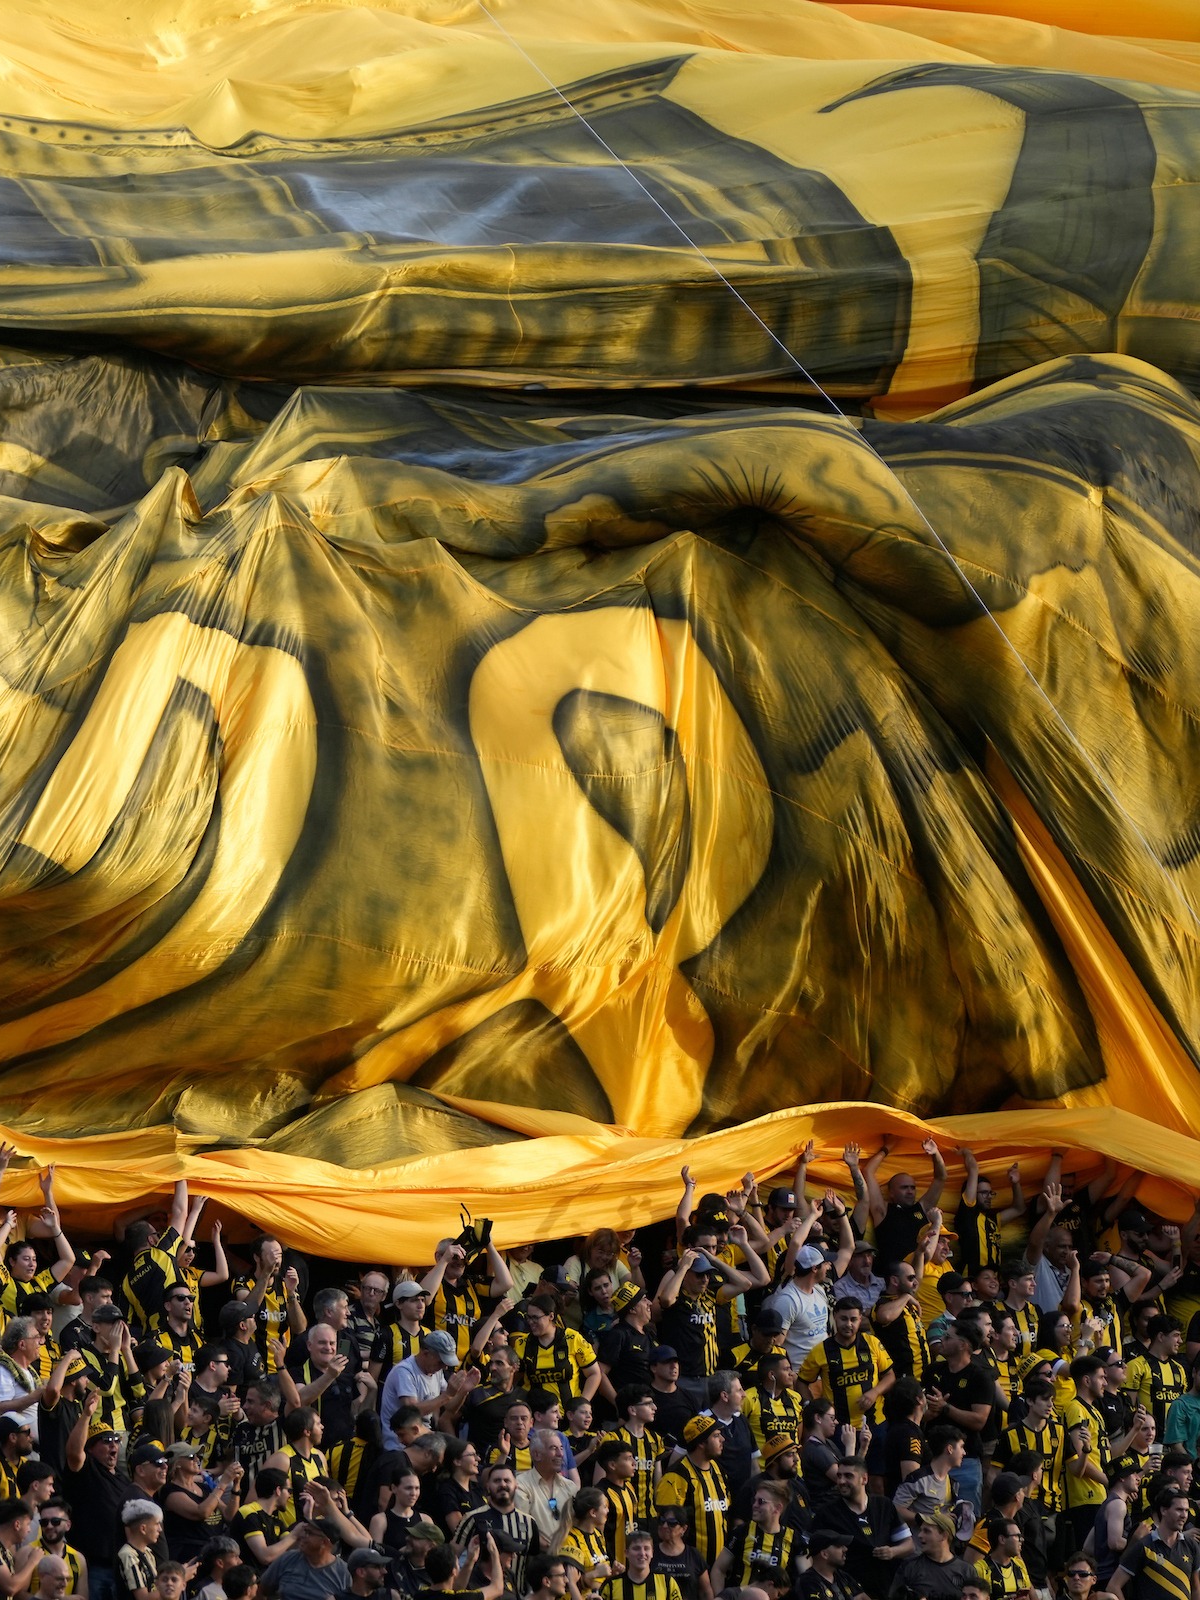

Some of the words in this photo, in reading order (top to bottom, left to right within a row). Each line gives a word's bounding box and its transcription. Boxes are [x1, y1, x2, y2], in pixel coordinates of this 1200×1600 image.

[130, 1265, 153, 1286] RENAU
[441, 1312, 477, 1327] ANCE
[529, 1368, 567, 1383] antel
[836, 1369, 869, 1386] antel
[767, 1419, 797, 1432] antel
[239, 1438, 268, 1455] antel
[1042, 1457, 1054, 1469] tel
